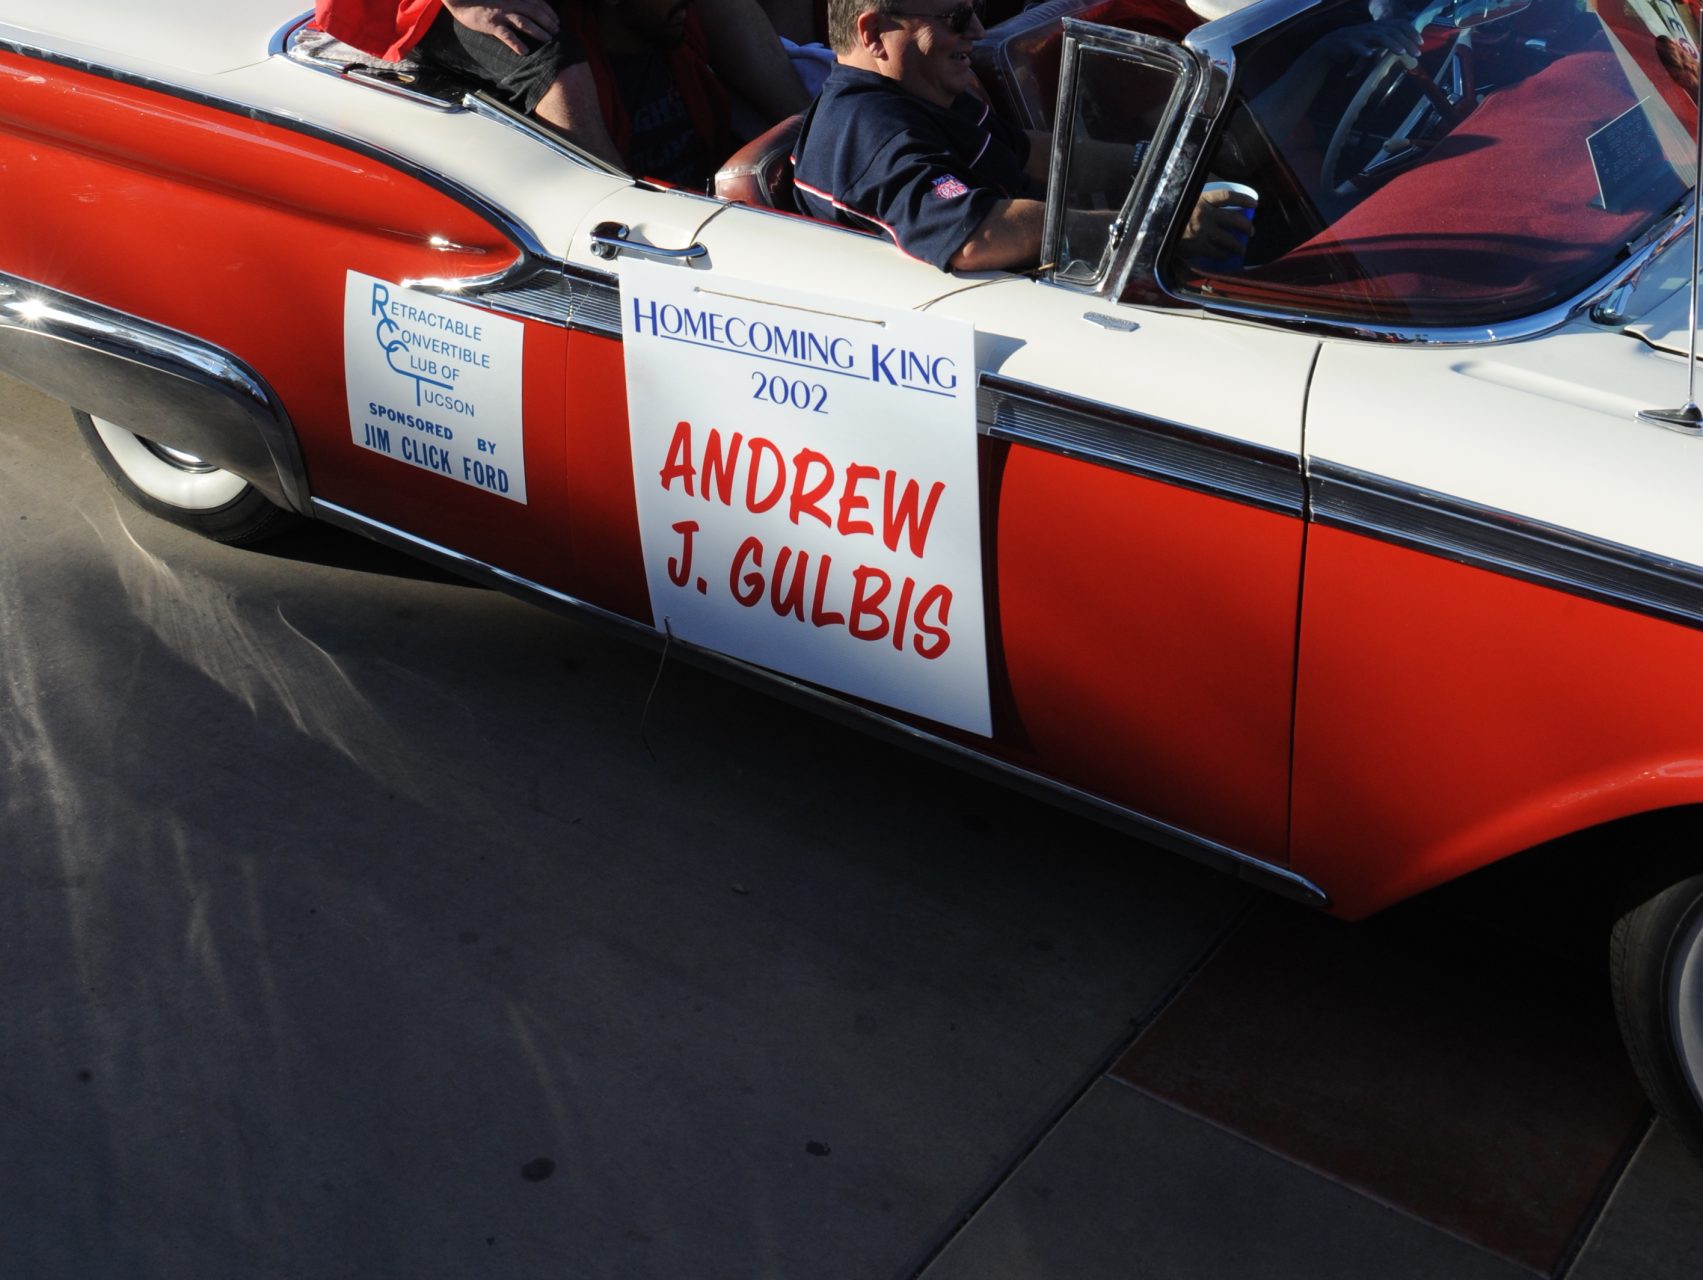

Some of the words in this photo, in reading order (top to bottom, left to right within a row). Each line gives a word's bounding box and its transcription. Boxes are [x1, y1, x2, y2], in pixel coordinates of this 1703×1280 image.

[371, 283, 482, 342] RETRACTABLE
[377, 318, 491, 369] CONVERTIBLE
[633, 297, 855, 369] HOMECOMING
[871, 344, 957, 389] KING
[441, 365, 460, 382] OF
[751, 371, 829, 414] 2002
[369, 402, 453, 441] SPONSORED
[477, 438, 496, 455] BY
[365, 423, 391, 454] JIM
[402, 436, 452, 475] CLICK
[463, 457, 509, 494] FORD
[659, 421, 947, 559] ANDREW
[667, 521, 708, 596] J.
[729, 536, 953, 660] GULBIS
